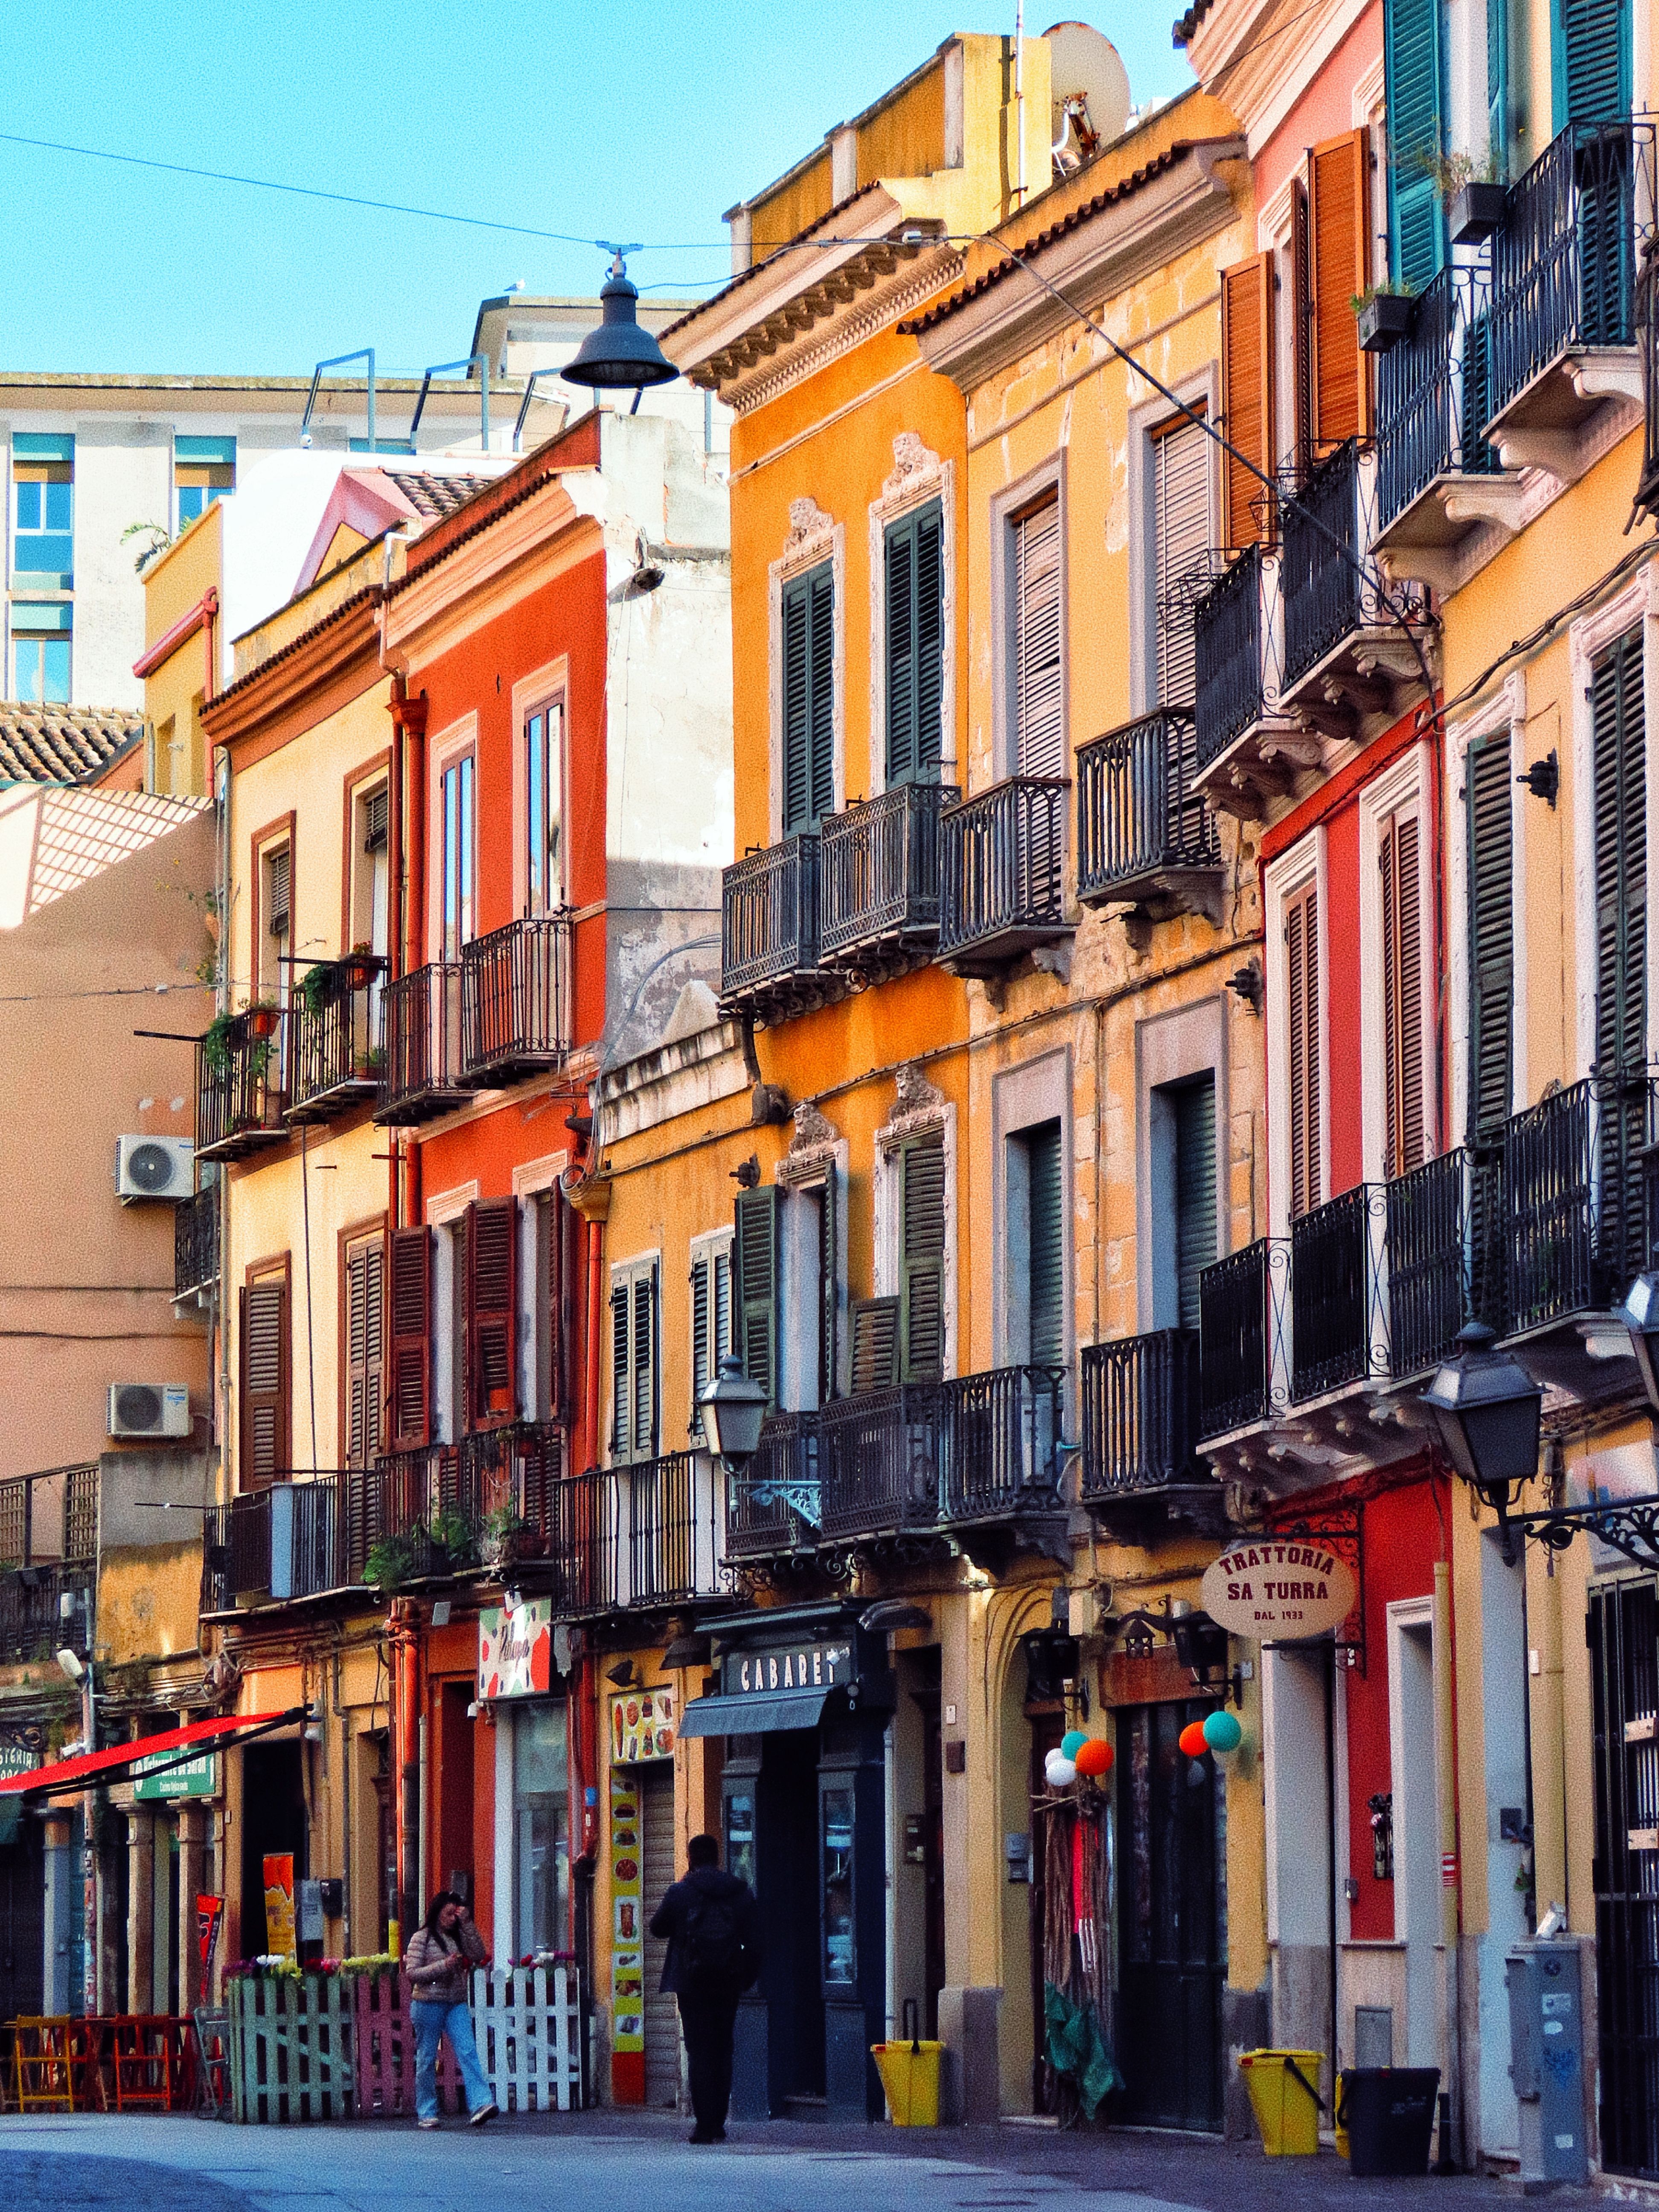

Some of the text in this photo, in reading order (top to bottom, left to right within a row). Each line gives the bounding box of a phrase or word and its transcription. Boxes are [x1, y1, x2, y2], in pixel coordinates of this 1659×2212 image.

[1219, 1546, 1334, 1575] TRATTORIA
[1228, 1582, 1328, 1600] SA TURRA
[1254, 1611, 1303, 1620] DAL 1933
